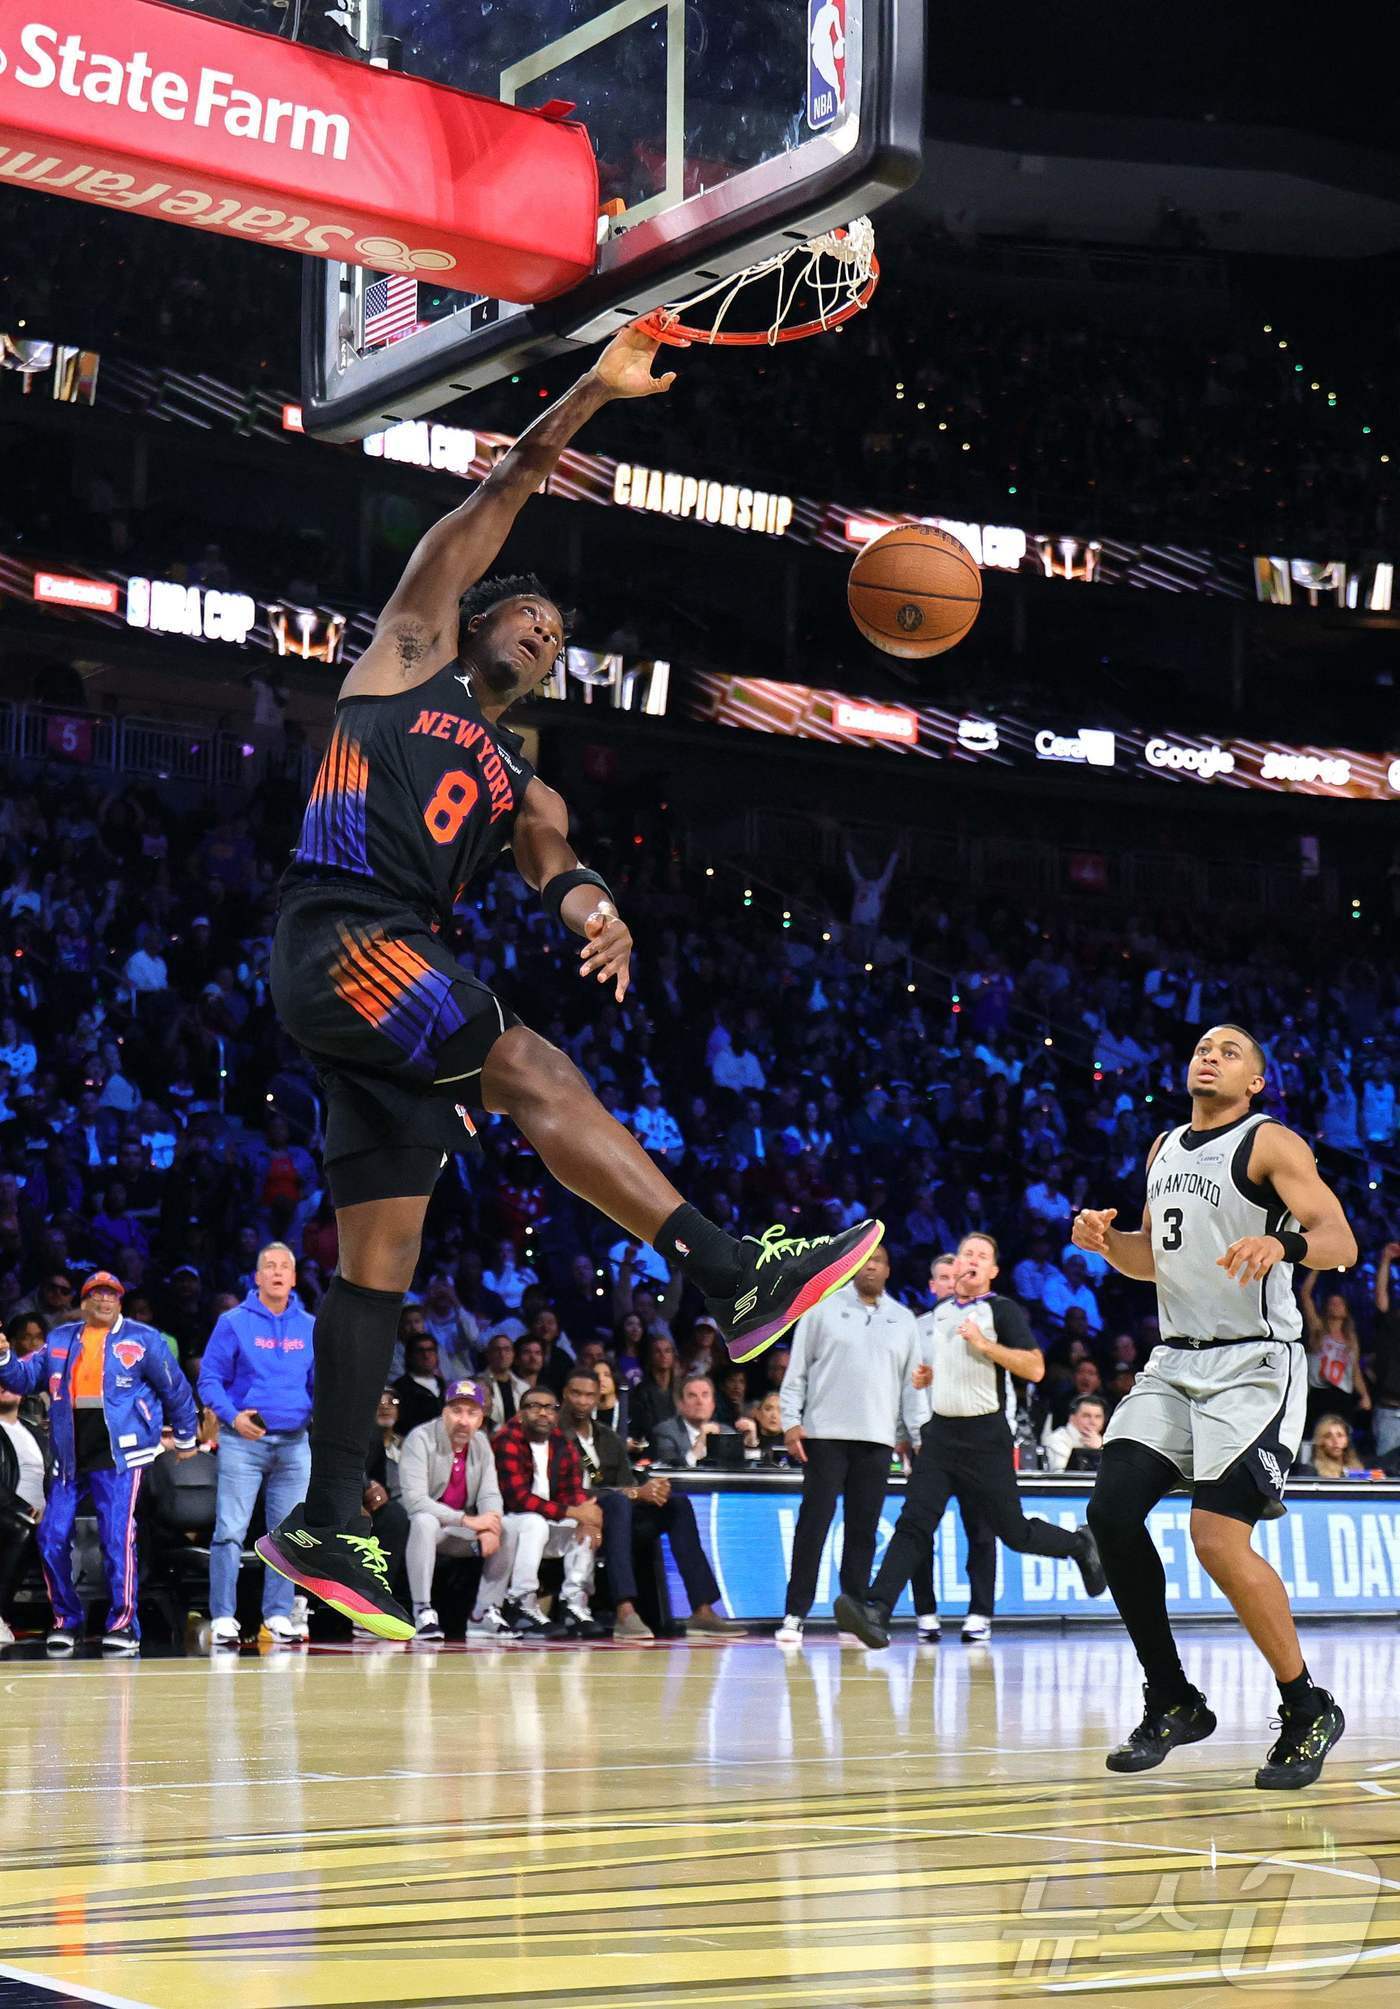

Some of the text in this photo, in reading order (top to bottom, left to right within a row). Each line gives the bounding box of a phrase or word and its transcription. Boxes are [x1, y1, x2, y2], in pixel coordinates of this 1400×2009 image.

[813, 90, 833, 120] NBA
[614, 463, 793, 535] CHAMPIONSHIP
[408, 710, 485, 749] NEW
[476, 736, 514, 825] YORK
[1145, 739, 1235, 778] Google
[424, 769, 478, 844] 8
[1163, 1173, 1221, 1208] ANTONIO
[1162, 1208, 1184, 1251] 3
[1327, 1513, 1400, 1599] DAY
